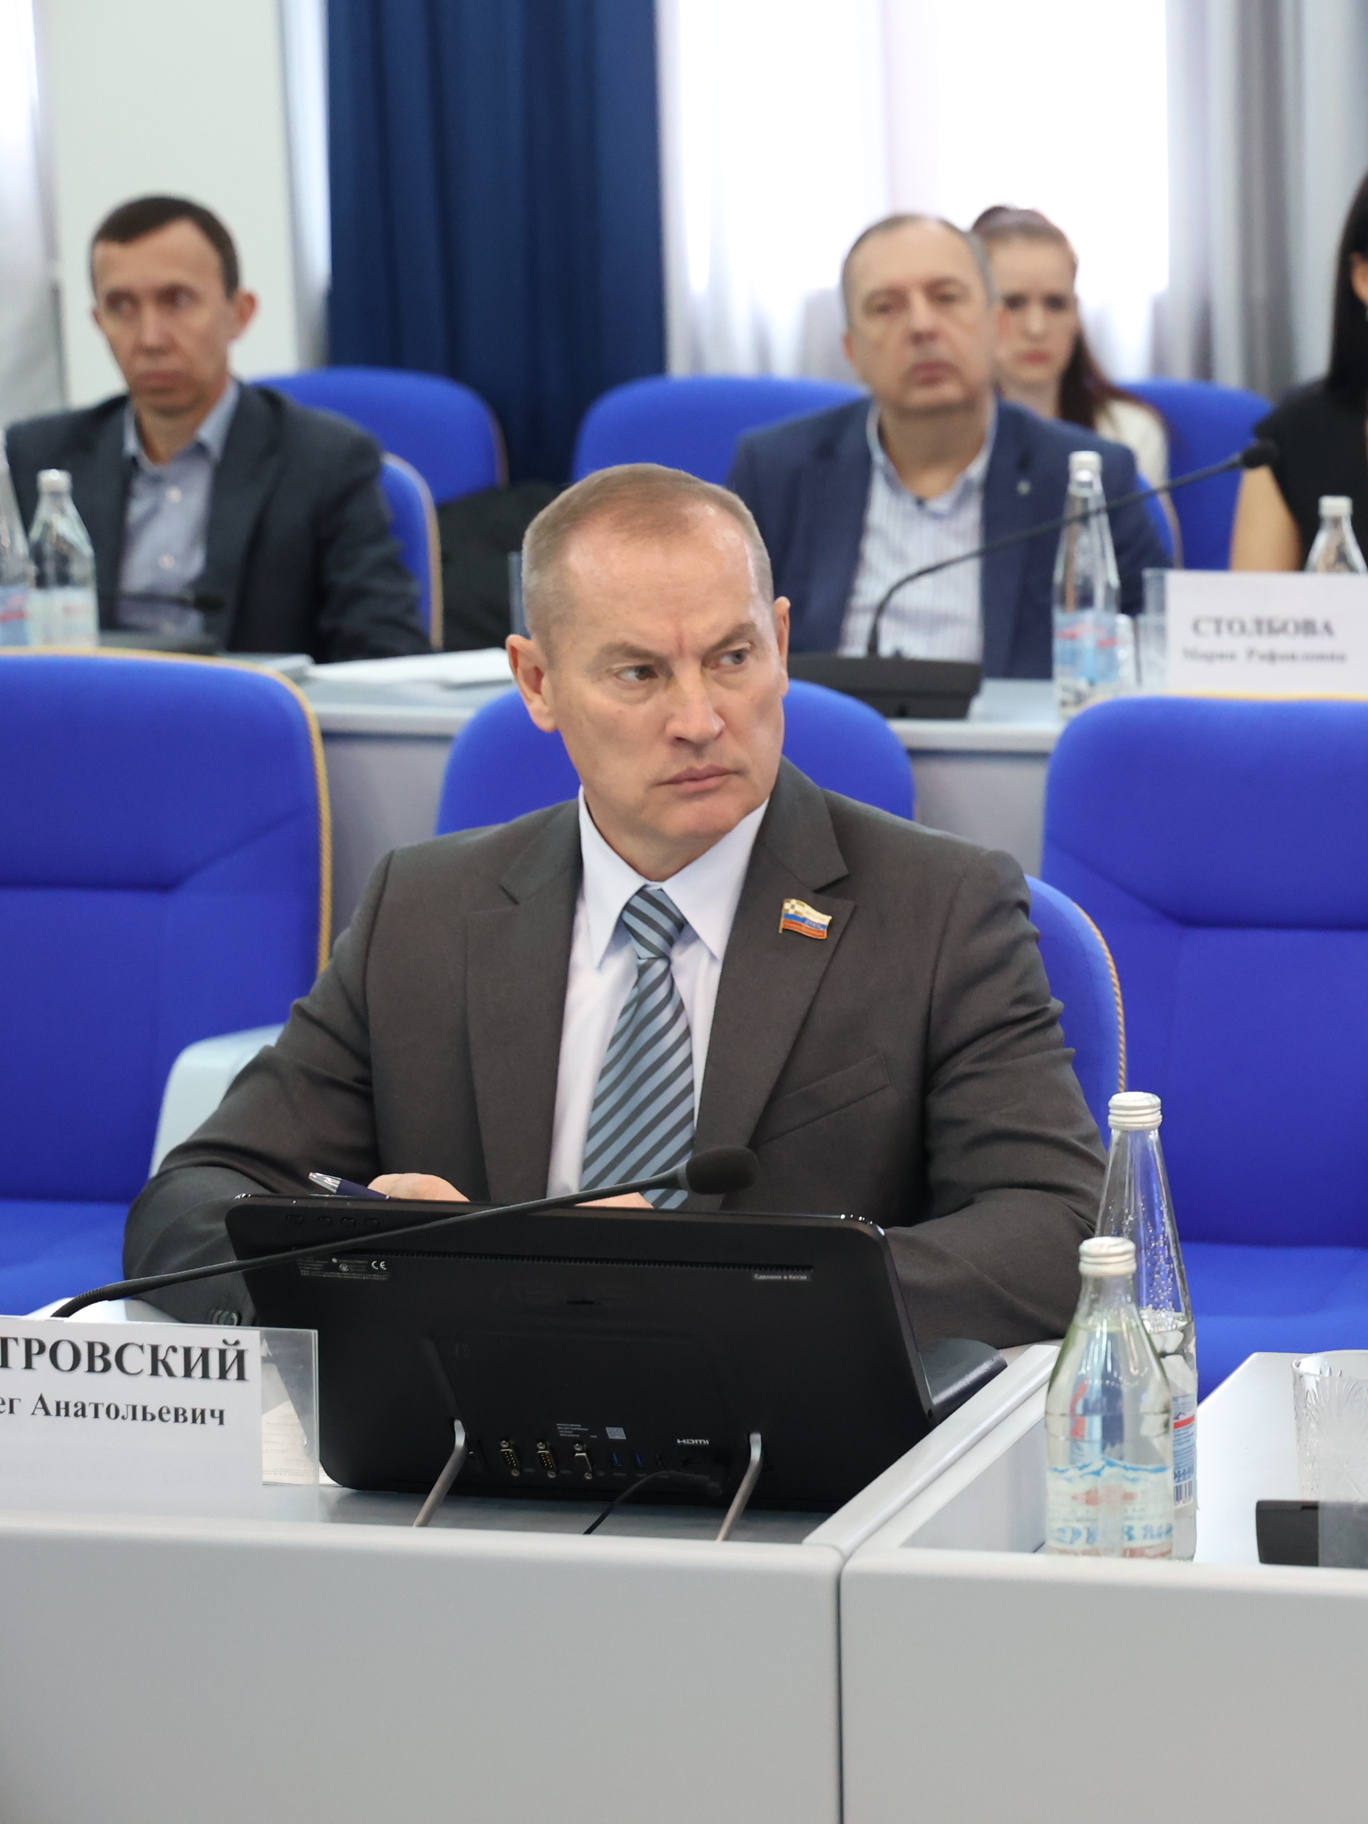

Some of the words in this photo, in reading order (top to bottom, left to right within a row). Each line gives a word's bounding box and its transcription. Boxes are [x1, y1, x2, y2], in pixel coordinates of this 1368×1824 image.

[1192, 616, 1335, 638] СТОЛБОВА
[0, 1336, 250, 1382] ТРОВСКИЙ
[30, 1392, 226, 1427] Анатольевич
